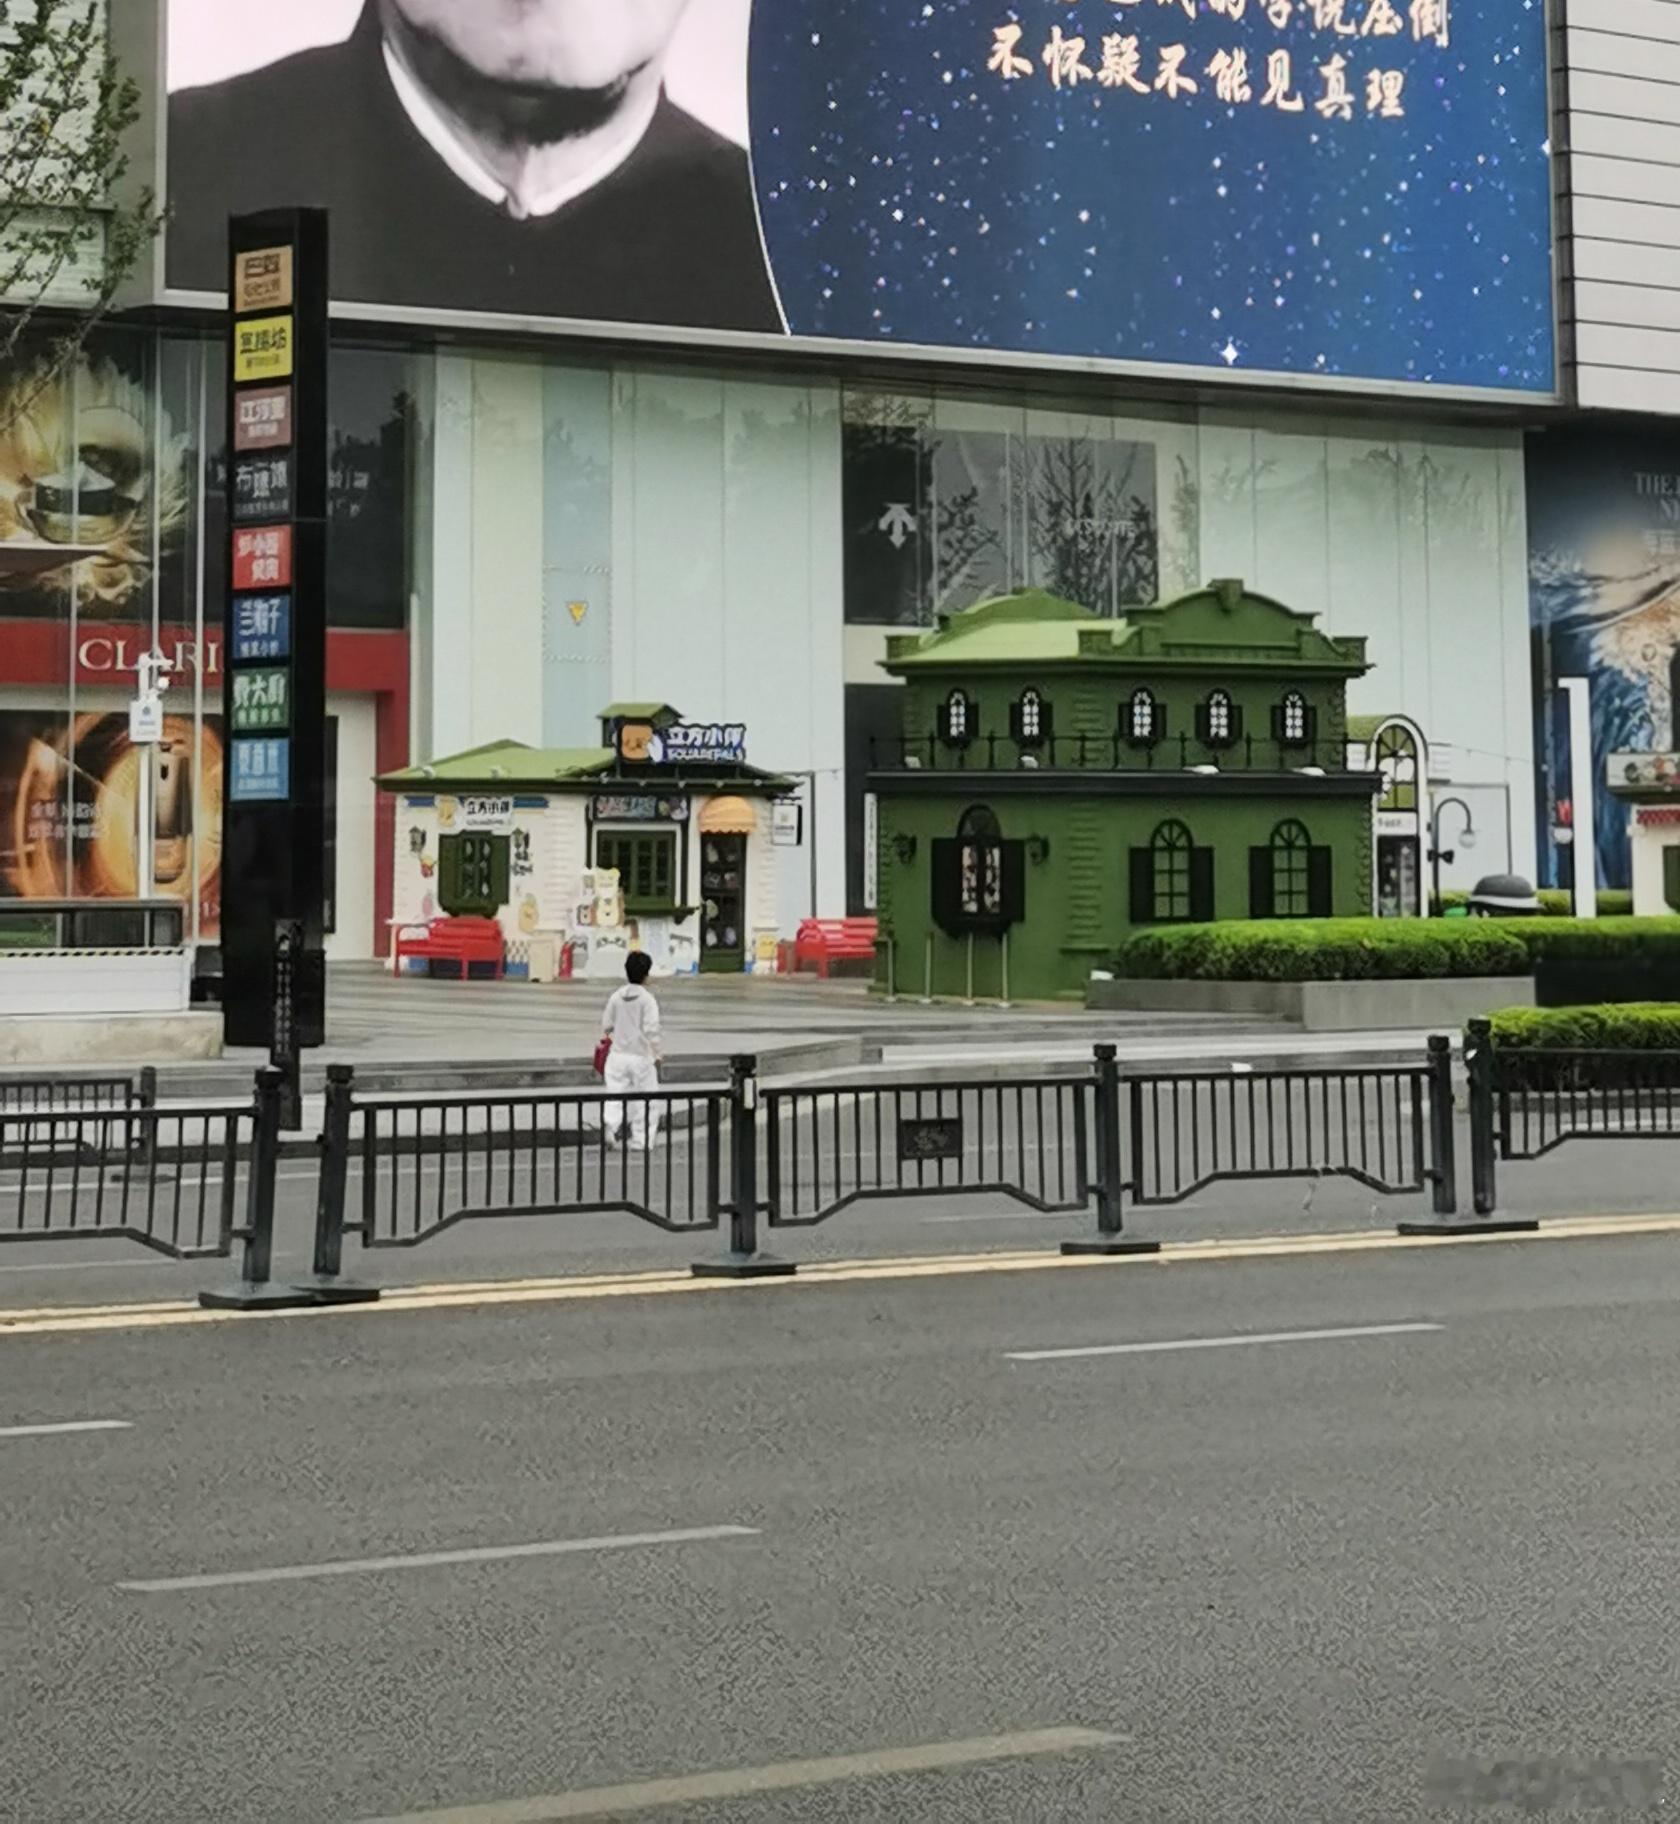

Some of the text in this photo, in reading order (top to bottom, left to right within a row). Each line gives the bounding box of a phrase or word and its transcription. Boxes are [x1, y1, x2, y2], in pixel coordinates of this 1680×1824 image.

[987, 24, 1406, 120] 不怀疑不能见真理
